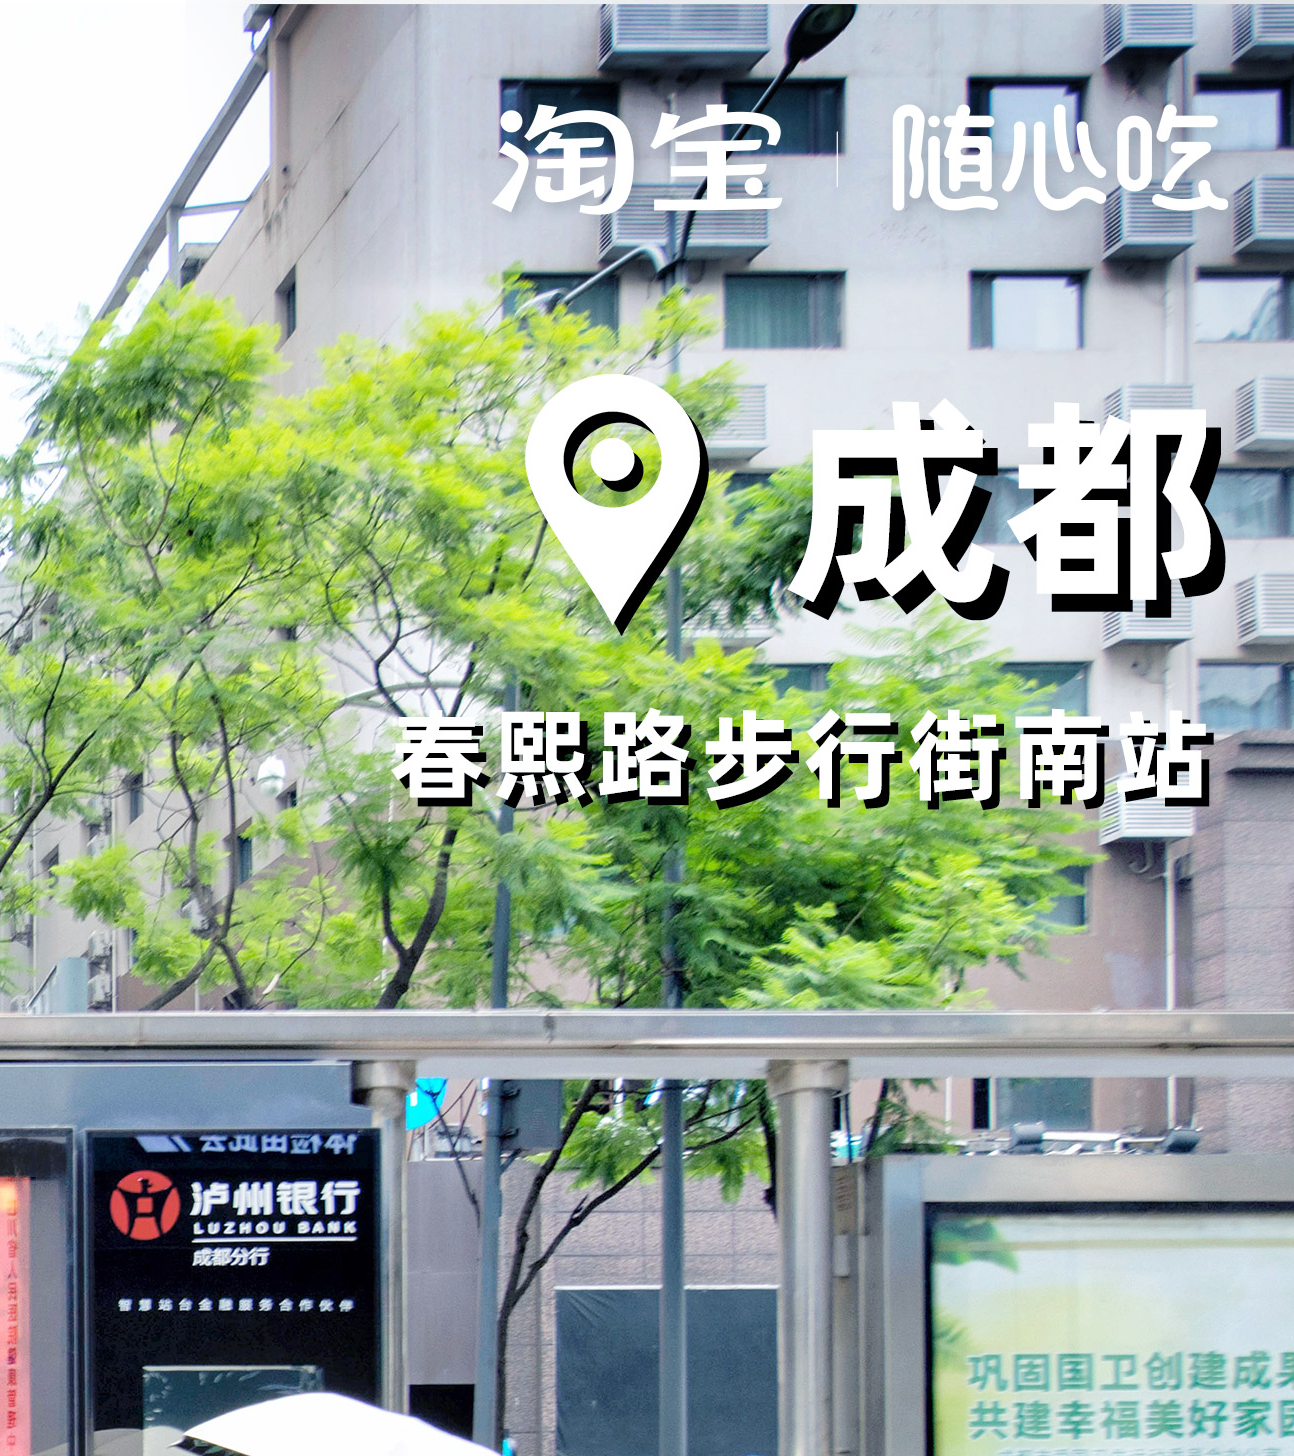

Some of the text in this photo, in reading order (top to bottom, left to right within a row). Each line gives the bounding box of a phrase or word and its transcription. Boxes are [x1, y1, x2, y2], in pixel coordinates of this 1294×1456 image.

[189, 1181, 360, 1216] 泸州银行
[193, 1220, 358, 1235] LUZHOU BANK
[192, 1247, 271, 1267] 成都分行
[118, 1298, 356, 1312] 智慧站台金融服务合作伙伴
